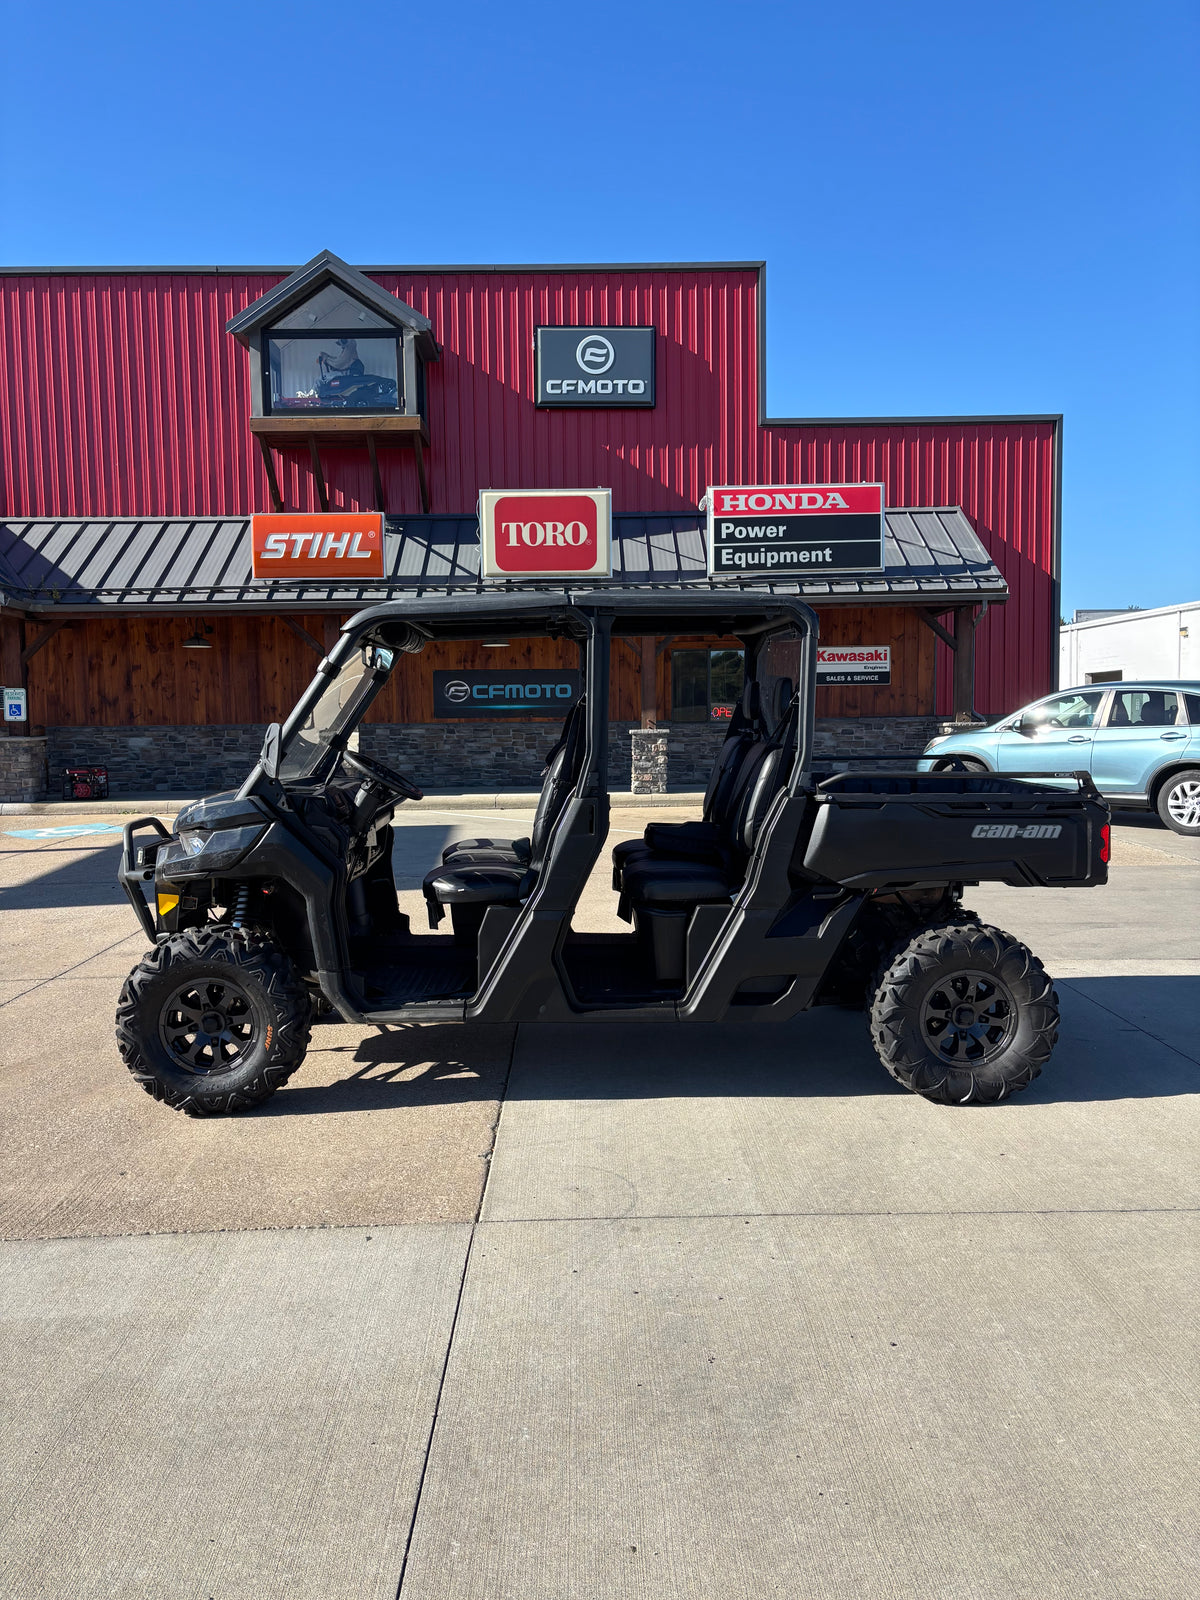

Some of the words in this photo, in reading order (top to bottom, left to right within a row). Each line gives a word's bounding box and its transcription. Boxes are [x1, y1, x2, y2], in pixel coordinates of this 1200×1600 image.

[546, 380, 645, 394] CFMOTO
[721, 493, 850, 511] HONDA
[501, 521, 588, 547] TORO
[721, 523, 787, 539] Power
[260, 532, 372, 559] STIHL
[721, 547, 833, 568] Equipment
[816, 649, 888, 662] Kawasaki
[472, 684, 572, 699] CFMOTO
[712, 706, 733, 718] OPE
[971, 824, 1062, 839] can-am
